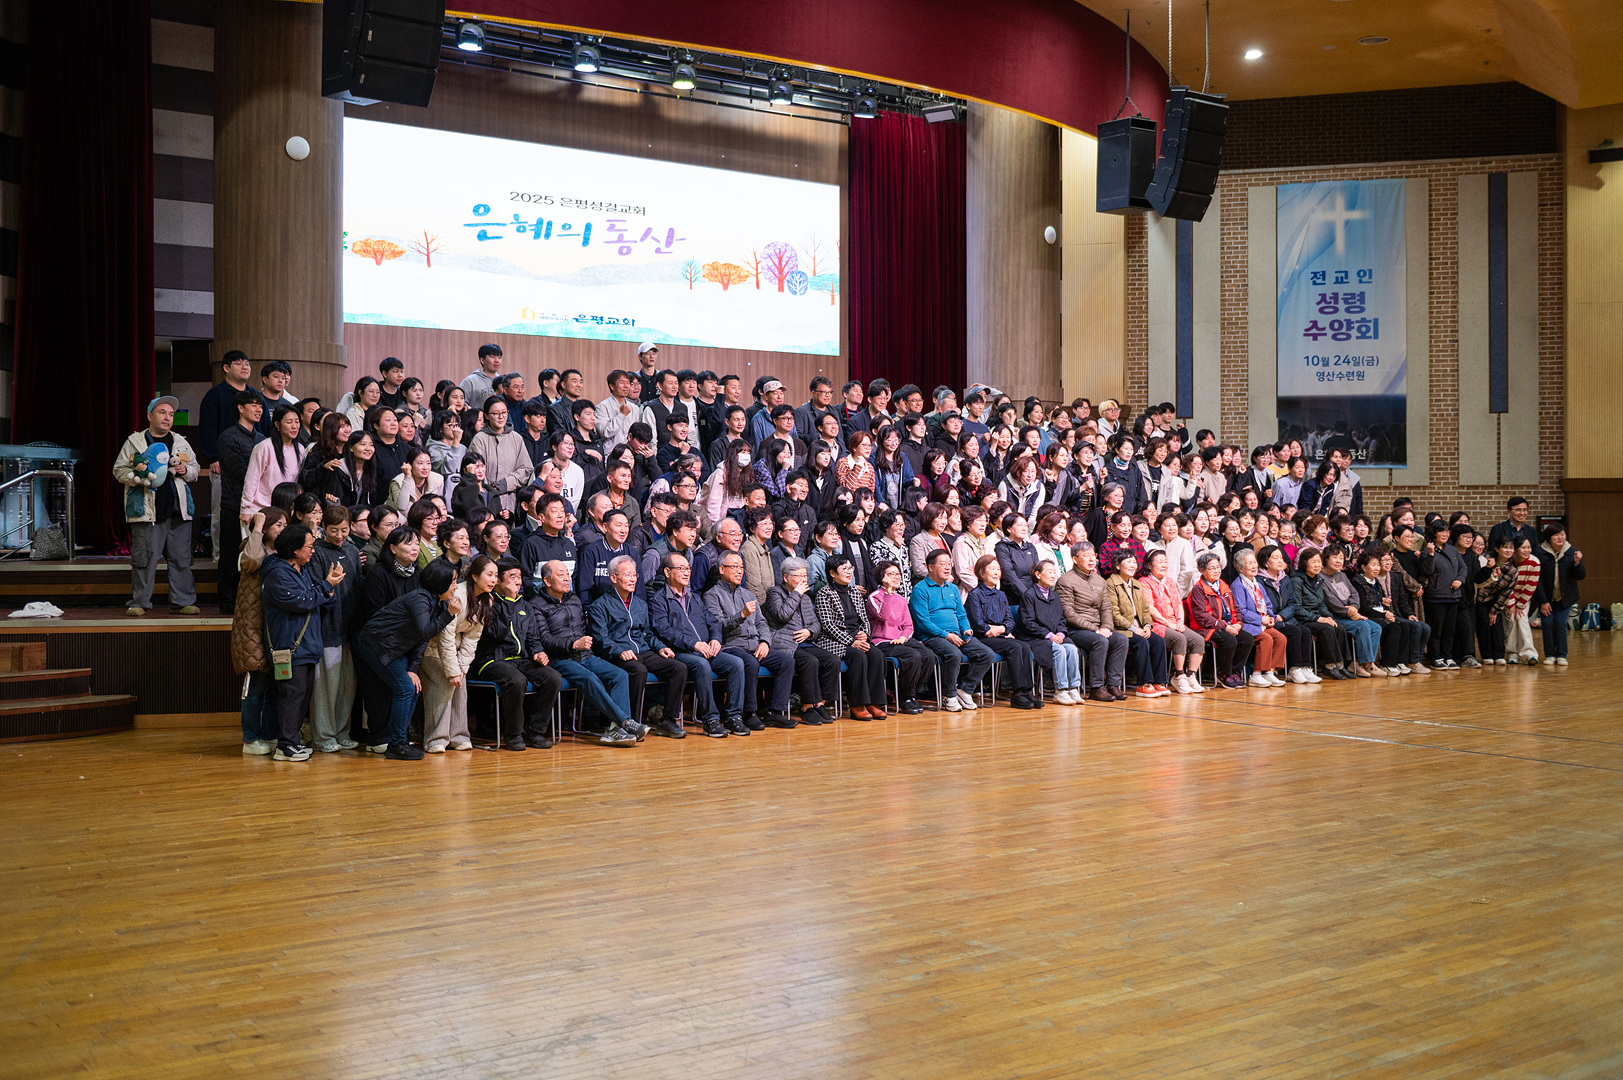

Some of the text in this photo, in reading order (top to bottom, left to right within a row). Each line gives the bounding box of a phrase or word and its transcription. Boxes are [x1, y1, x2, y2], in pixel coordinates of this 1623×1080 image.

[509, 191, 646, 216] 2025 은평성결교회
[463, 203, 687, 256] 은혜의 동산
[1315, 291, 1366, 315] 성령
[572, 314, 635, 327] 은평교회
[1303, 317, 1379, 341] 수양회
[1303, 354, 1379, 367] 10월 24일(금)
[1315, 370, 1365, 382] 영산수련원
